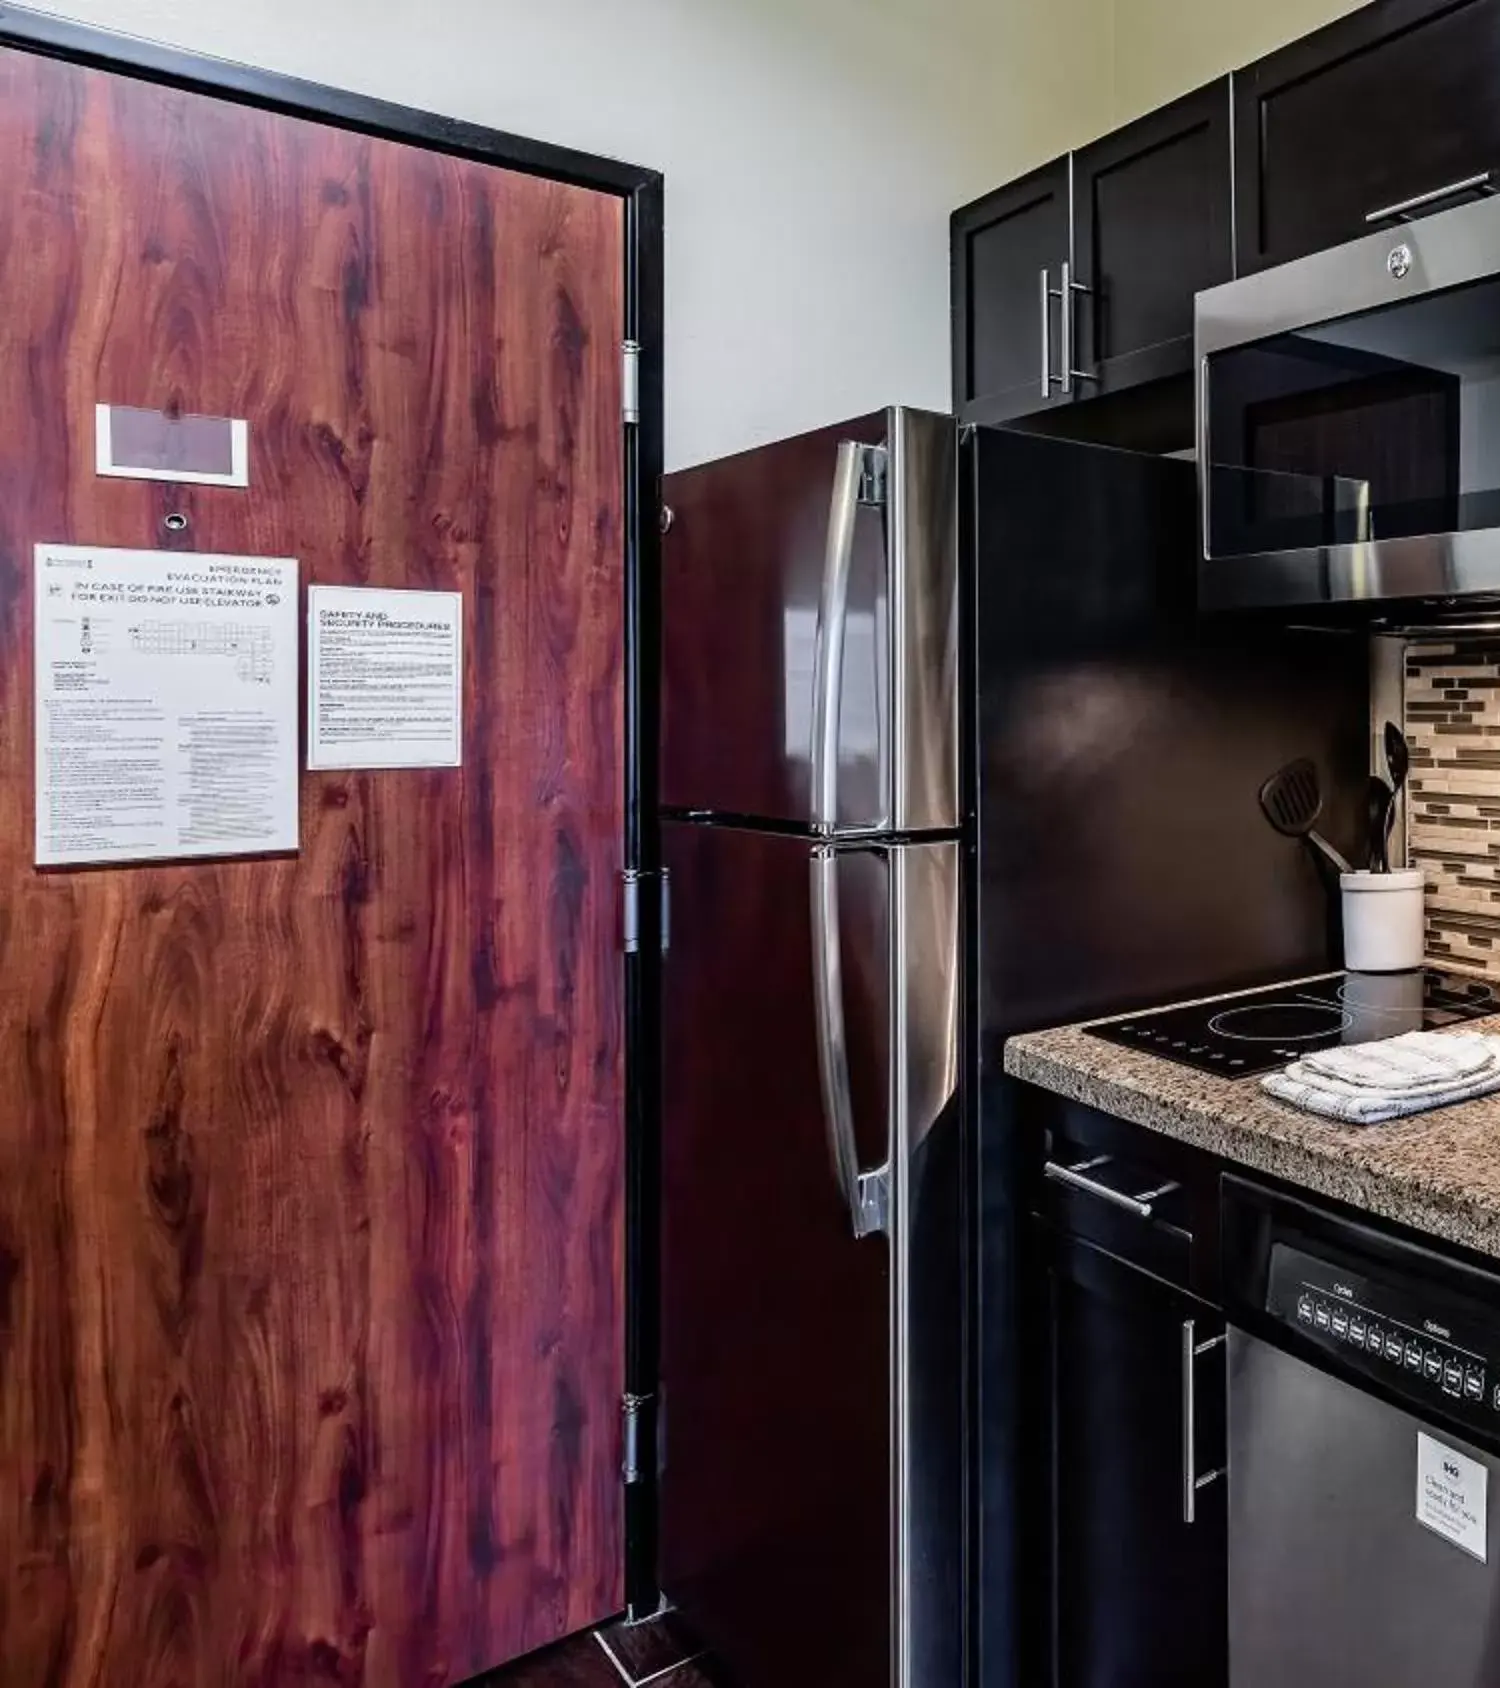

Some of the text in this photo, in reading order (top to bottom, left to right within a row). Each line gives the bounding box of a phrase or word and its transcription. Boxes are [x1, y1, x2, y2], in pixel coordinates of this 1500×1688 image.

[208, 565, 282, 576] EMERGENCY
[167, 573, 283, 586] EVACUATION PLAN
[74, 582, 262, 597] IN CASE OF FIRE USE STAIRWAY
[71, 592, 263, 608] FOR EXIT DO NOT USE ELEVATOR
[319, 609, 389, 621] SAFETY AND
[319, 619, 451, 631] SECURITY PROCEDURES
